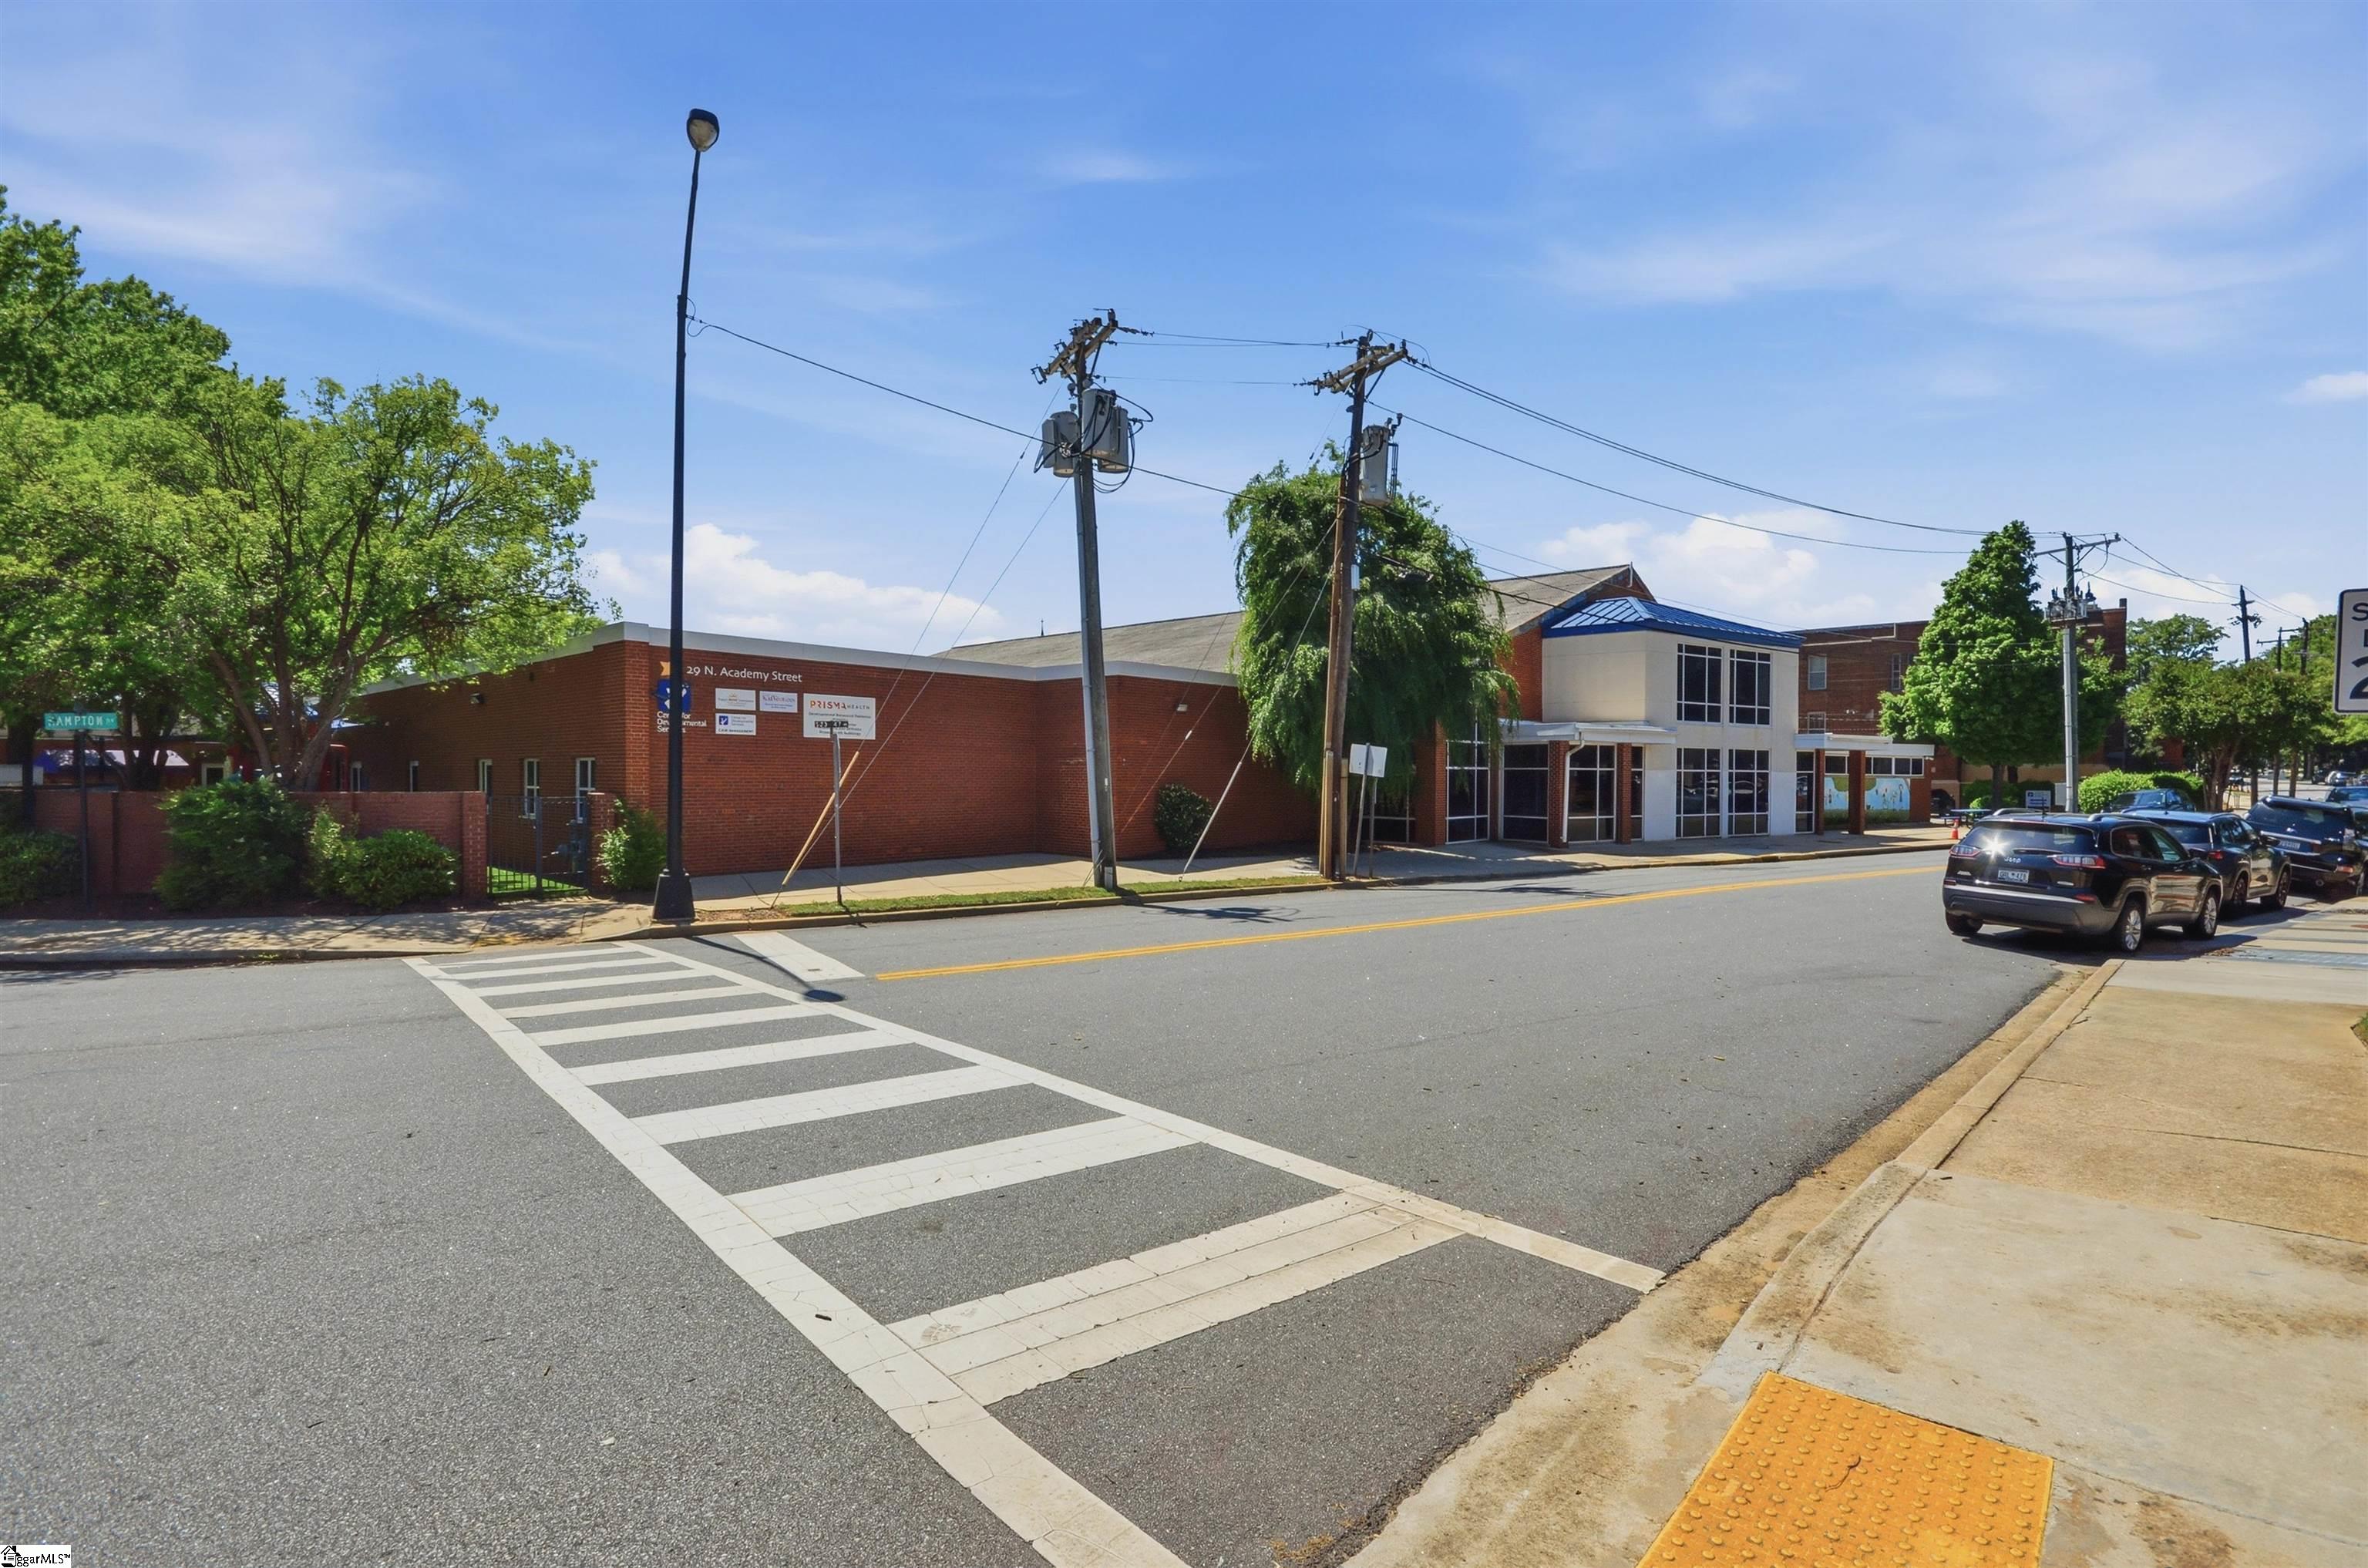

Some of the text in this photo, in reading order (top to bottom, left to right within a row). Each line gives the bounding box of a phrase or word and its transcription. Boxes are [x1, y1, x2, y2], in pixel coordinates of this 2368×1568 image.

[686, 666, 802, 682] 29 N. Academy Street
[810, 700, 847, 710] PRISMA
